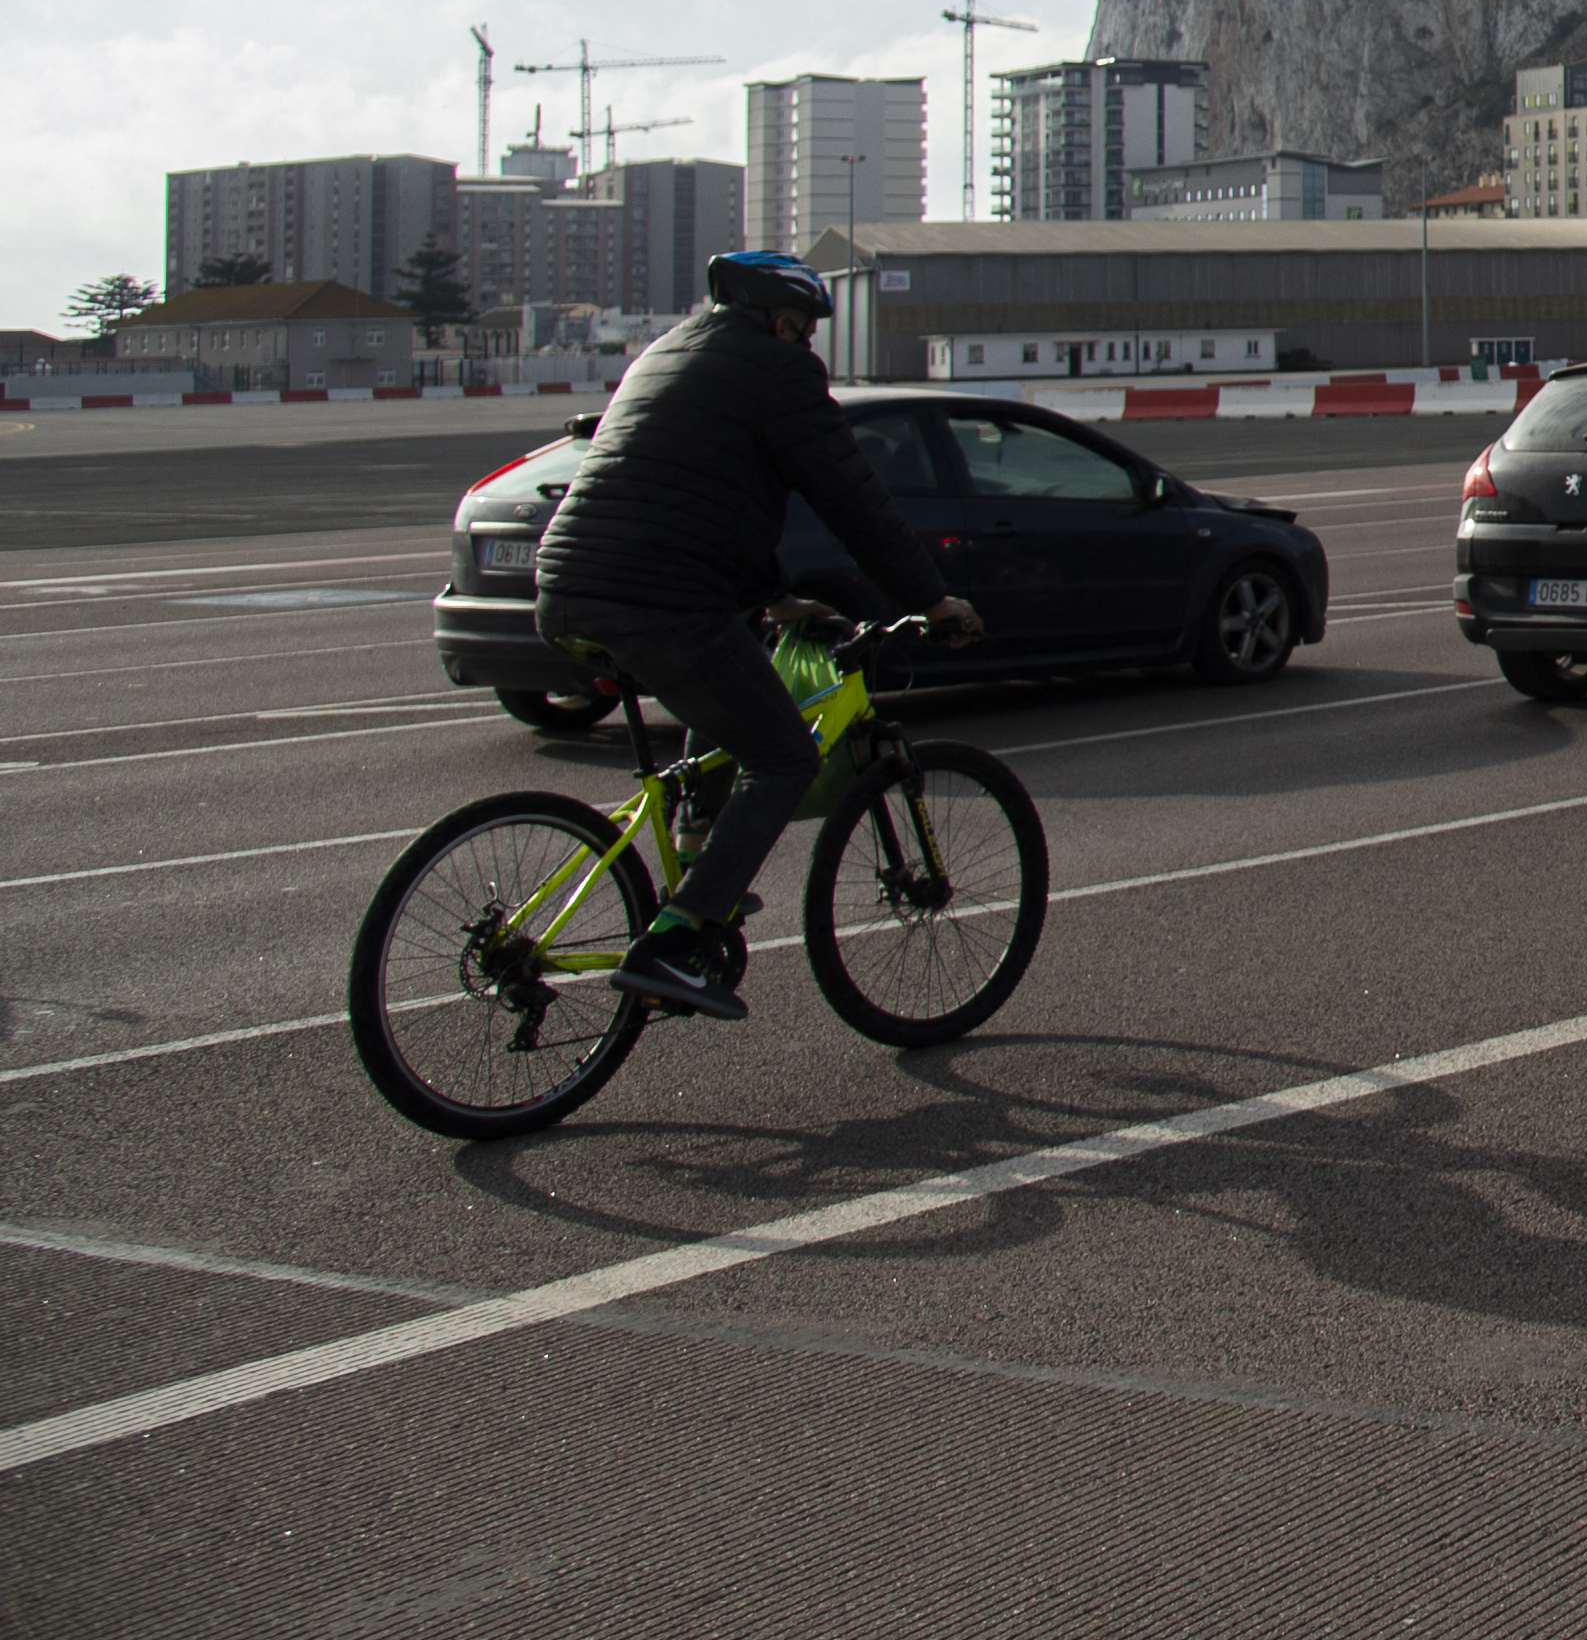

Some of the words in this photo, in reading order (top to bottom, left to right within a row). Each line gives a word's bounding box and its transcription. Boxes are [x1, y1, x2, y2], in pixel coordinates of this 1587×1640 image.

[495, 543, 532, 564] 0613
[1540, 582, 1580, 602] 0685
[916, 798, 946, 876] RALEIGH
